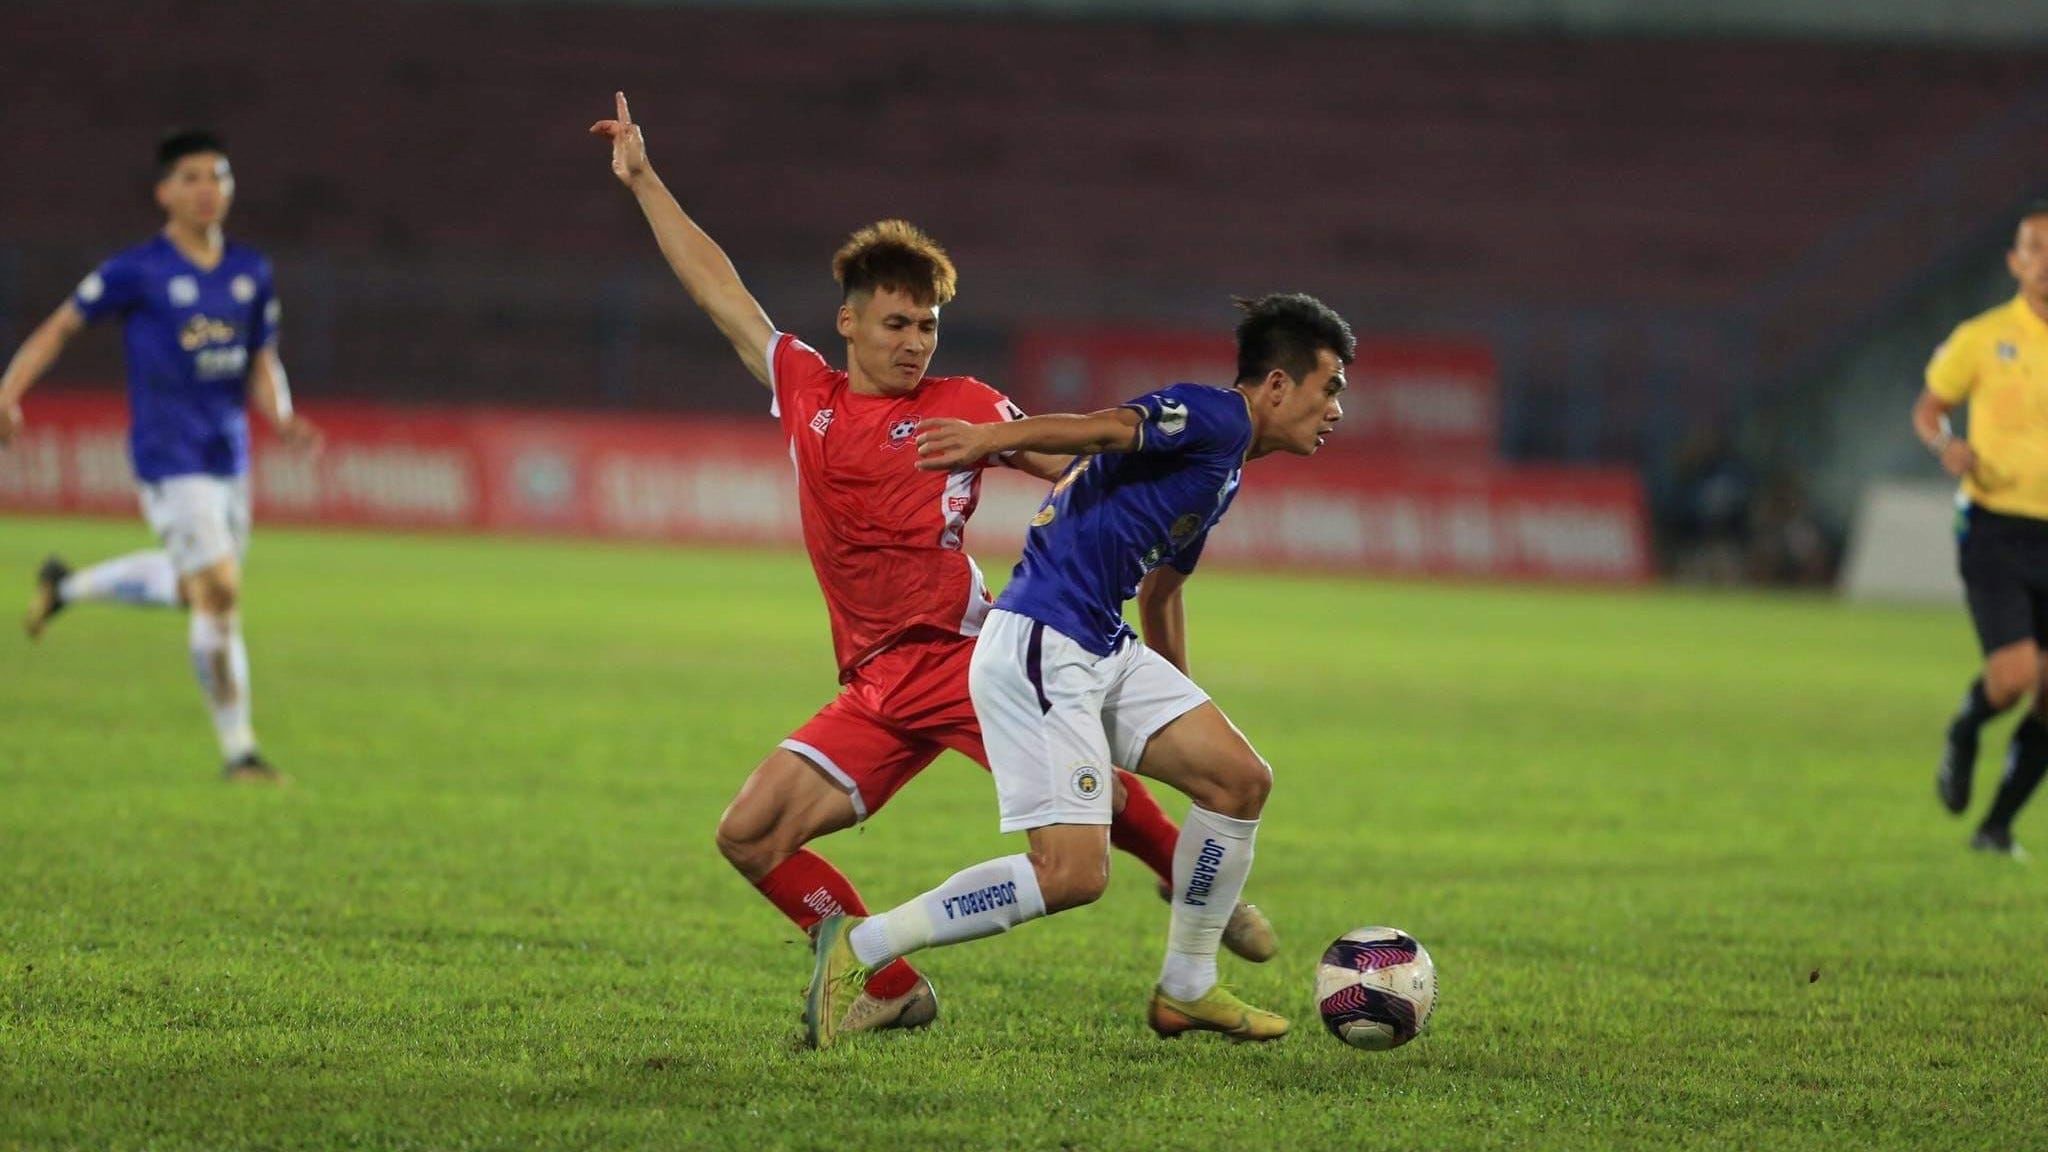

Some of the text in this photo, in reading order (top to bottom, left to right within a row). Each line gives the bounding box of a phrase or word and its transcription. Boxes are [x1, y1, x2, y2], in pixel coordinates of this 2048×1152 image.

[1184, 838, 1226, 906] JOGARBOLA
[803, 886, 846, 919] JOGAR
[942, 880, 1018, 920] JOGARBOLA
